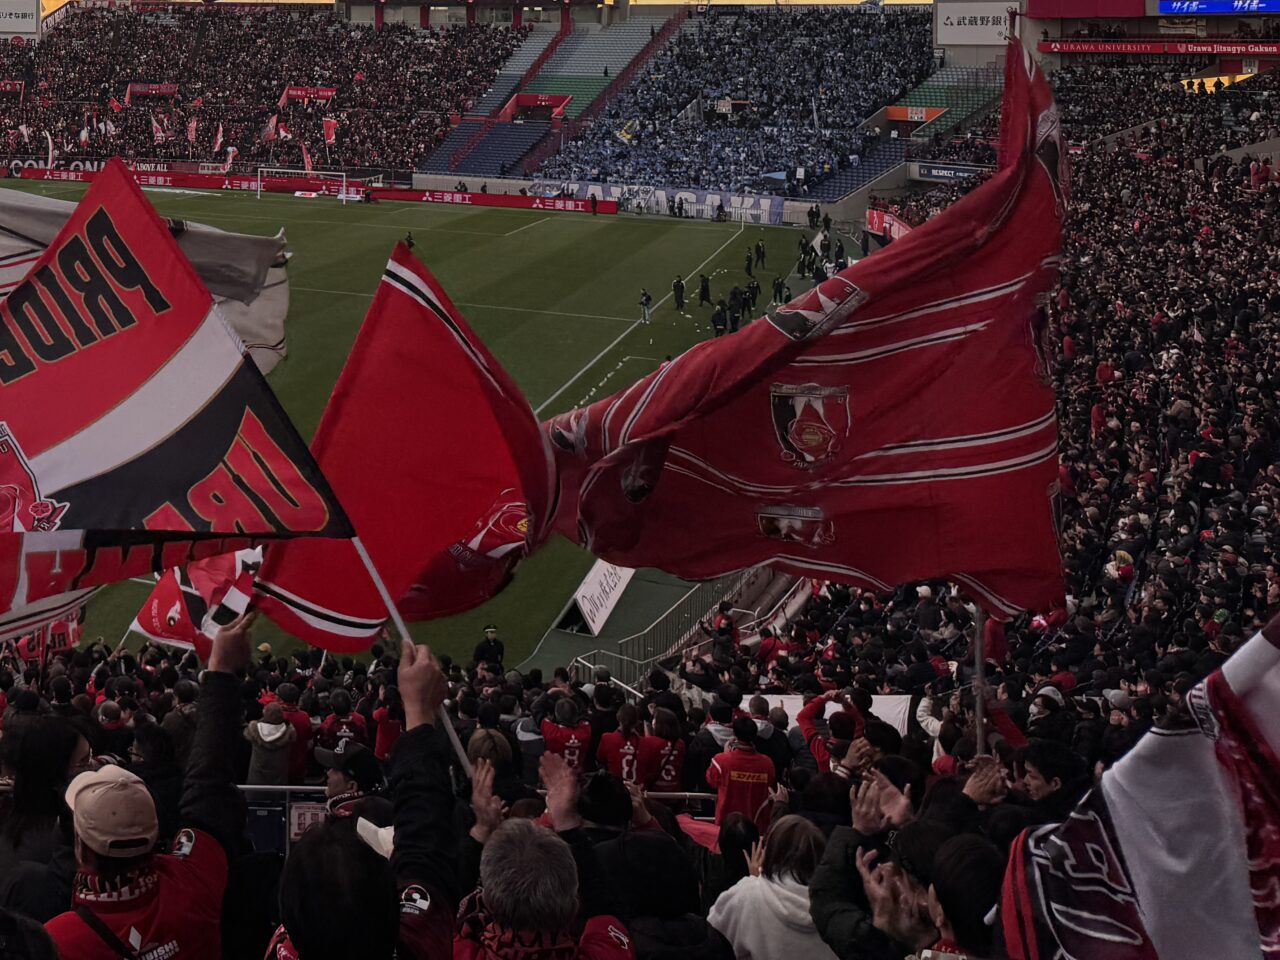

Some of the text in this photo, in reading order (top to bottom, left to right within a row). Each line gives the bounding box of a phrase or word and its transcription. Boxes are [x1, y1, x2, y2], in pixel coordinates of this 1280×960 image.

[1062, 44, 1153, 52] URAWA UNIVERSITY
[1187, 44, 1278, 54] Urawa Jitsugyo Gakuen
[157, 162, 170, 172] ALL
[544, 199, 585, 211] 三菱重工
